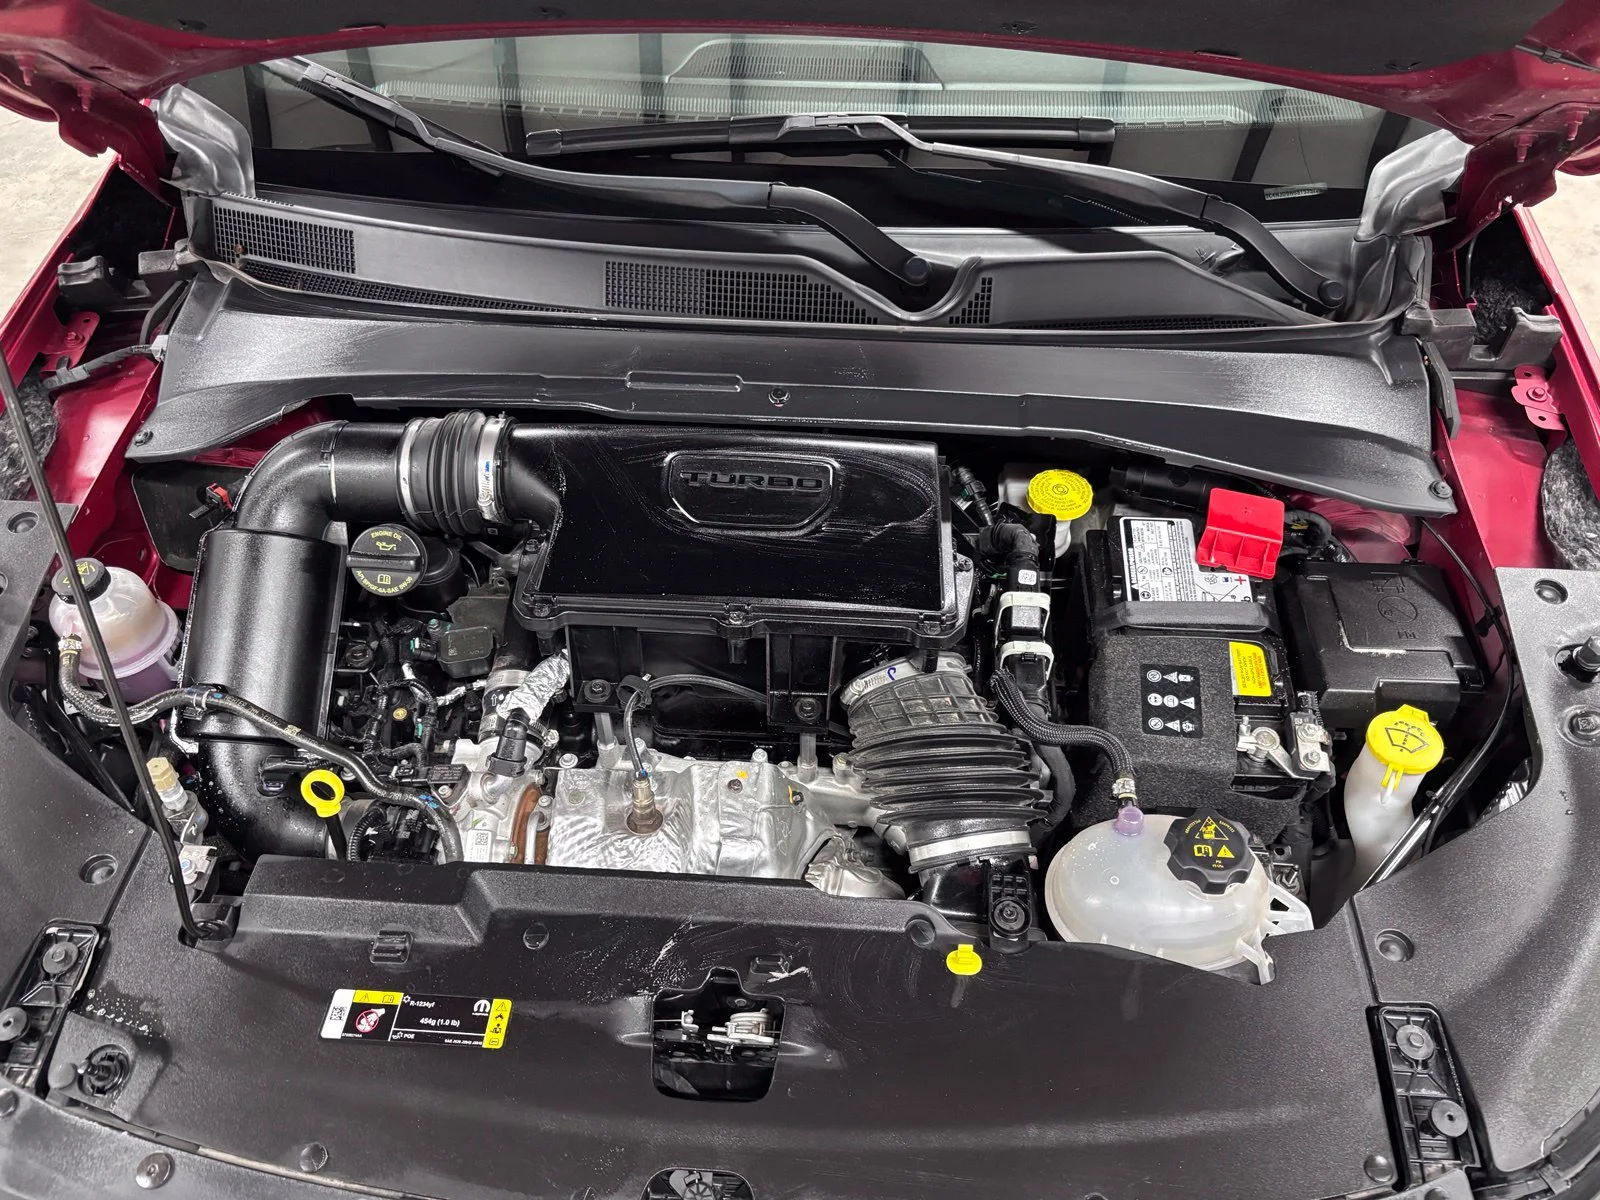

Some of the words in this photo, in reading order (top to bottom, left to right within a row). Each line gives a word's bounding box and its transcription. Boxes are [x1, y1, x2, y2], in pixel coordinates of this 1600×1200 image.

[680, 471, 824, 492] TURBO
[371, 530, 393, 538] ENGINE
[393, 531, 402, 541] OIL
[356, 570, 365, 580] API
[409, 1000, 436, 1009] R-1234yf
[420, 1017, 436, 1026] 454g
[436, 1018, 450, 1026] (1.0
[450, 1020, 460, 1028] lb)
